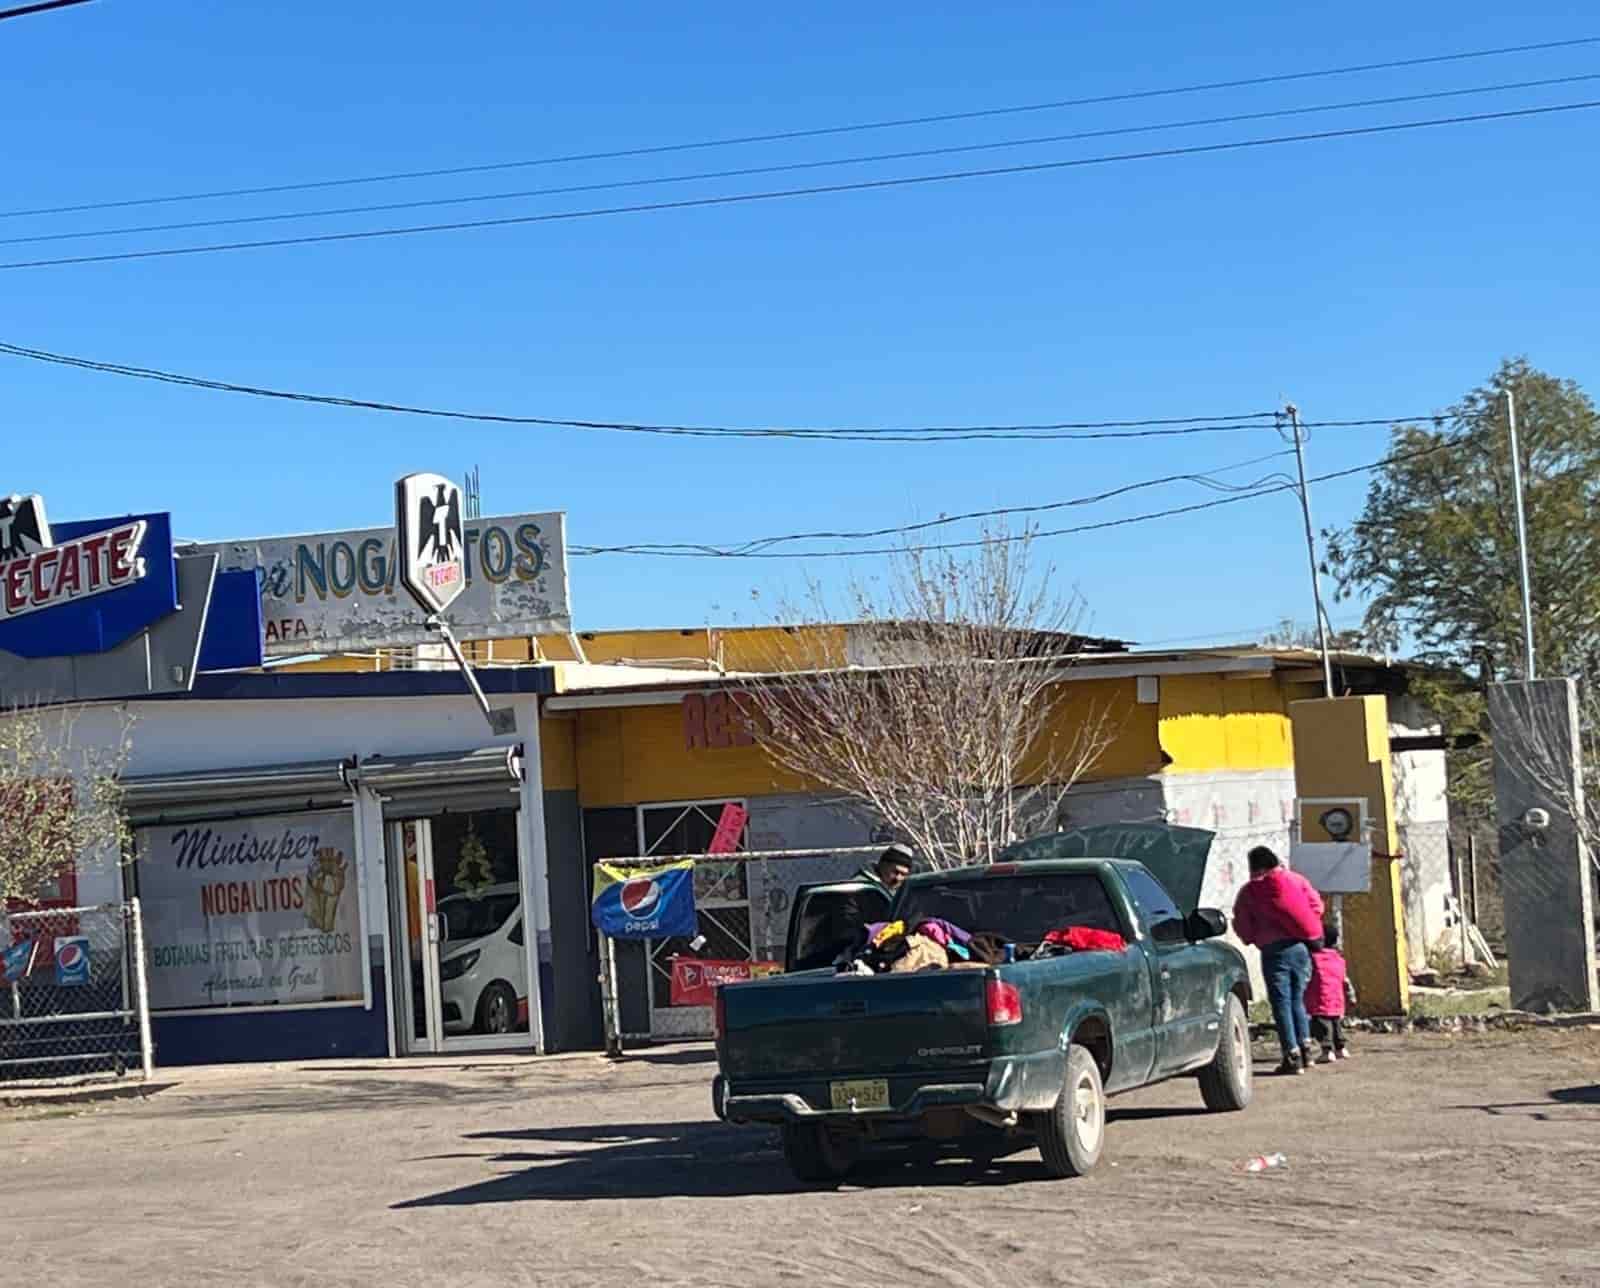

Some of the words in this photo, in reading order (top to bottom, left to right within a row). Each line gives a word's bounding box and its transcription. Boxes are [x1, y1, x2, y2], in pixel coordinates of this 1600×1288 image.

[0, 526, 141, 612] ECATE
[171, 828, 321, 873] Minisuper
[200, 877, 305, 917] NOGALITOS
[624, 919, 660, 932] pepsi
[153, 944, 210, 968] BOTANAS
[279, 932, 353, 958] REFRESCOS
